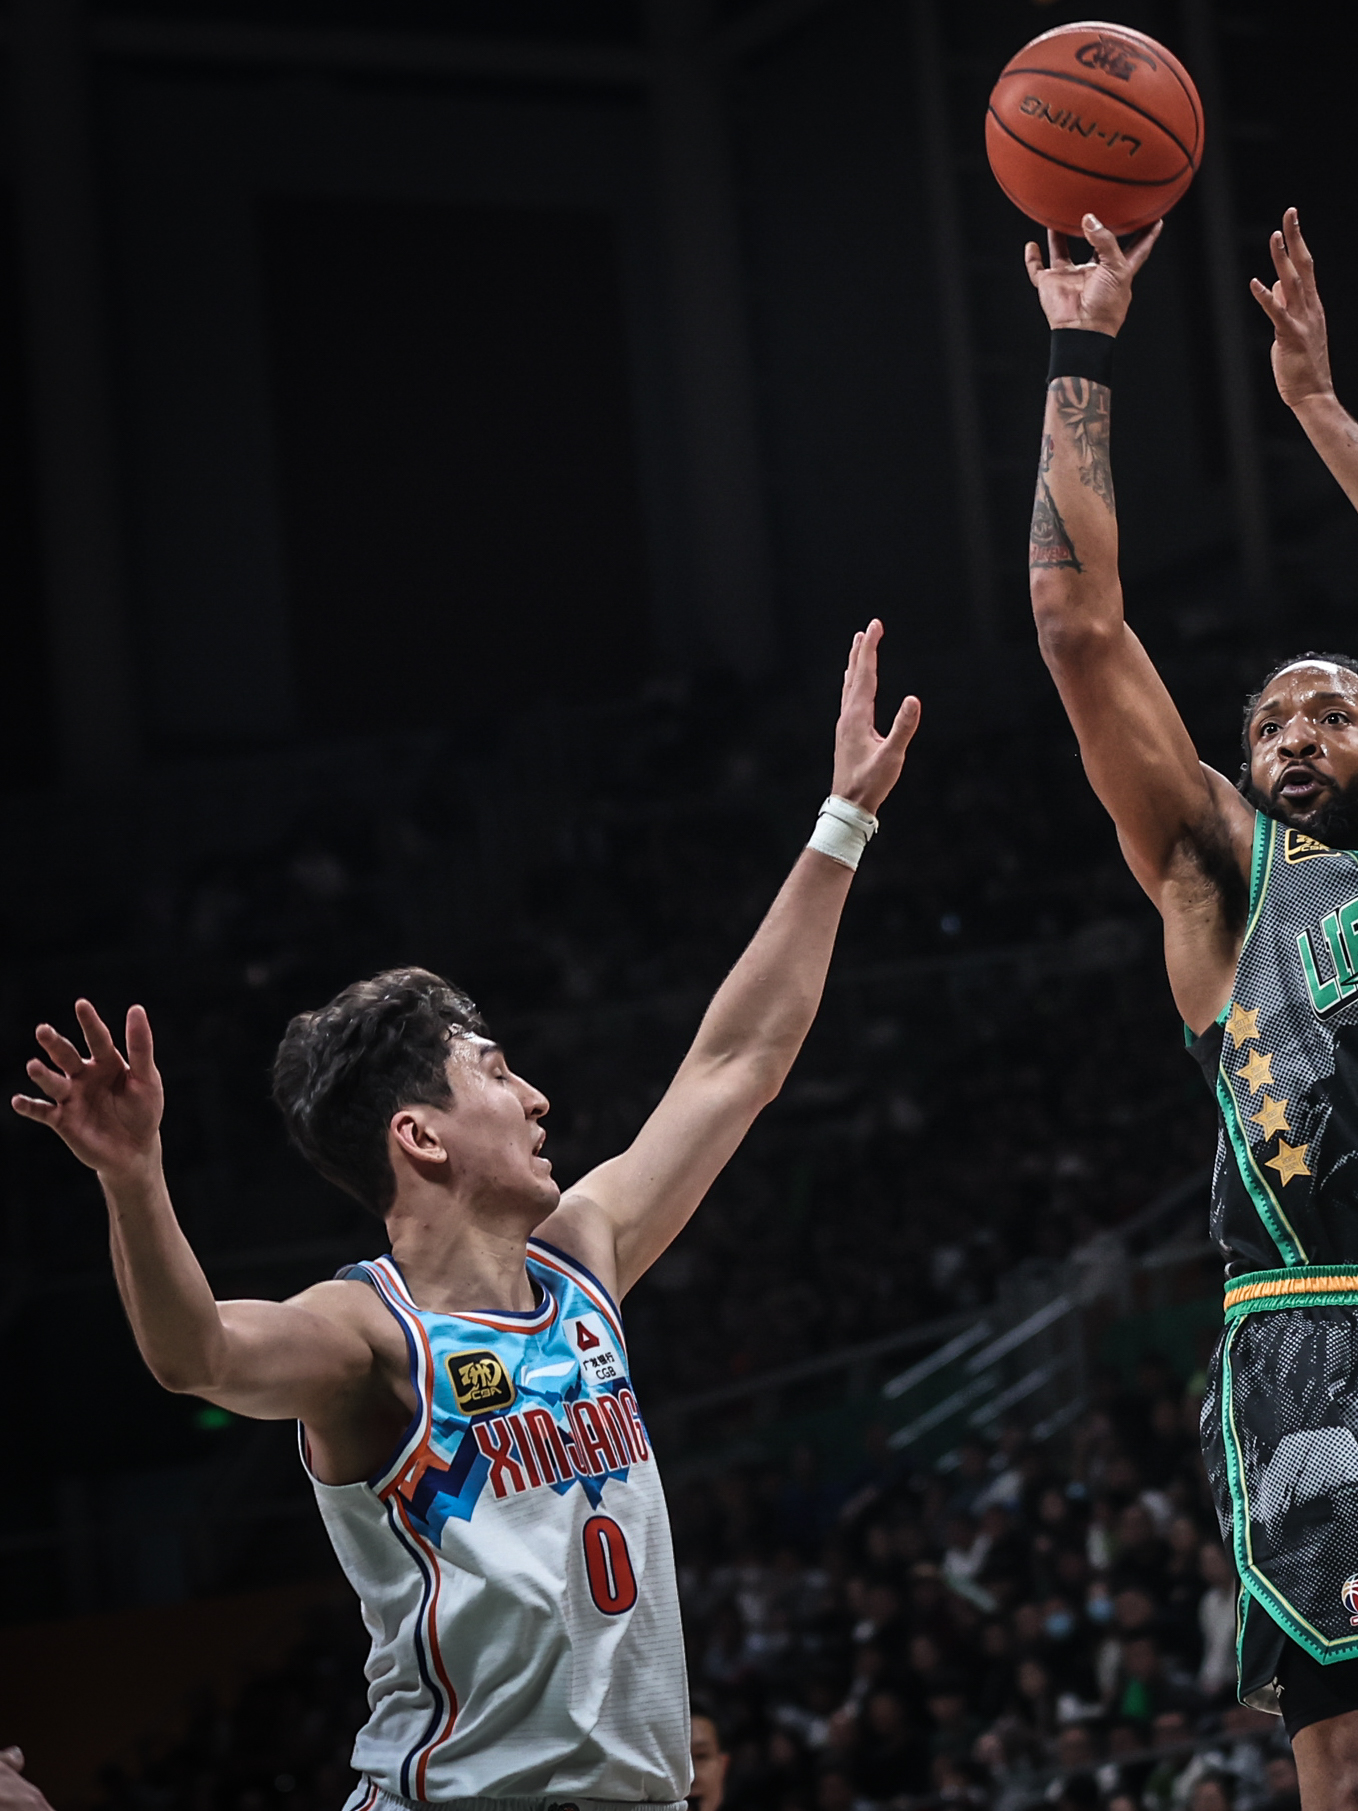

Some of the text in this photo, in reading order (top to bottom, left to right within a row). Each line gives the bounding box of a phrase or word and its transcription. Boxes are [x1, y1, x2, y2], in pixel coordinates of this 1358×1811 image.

[1019, 95, 1142, 157] LI-NING
[582, 1351, 616, 1371] 广发银行
[595, 1365, 617, 1380] CGB
[471, 1386, 503, 1401] CBA
[472, 1387, 649, 1499] XINJANG
[583, 1515, 638, 1616] 0
